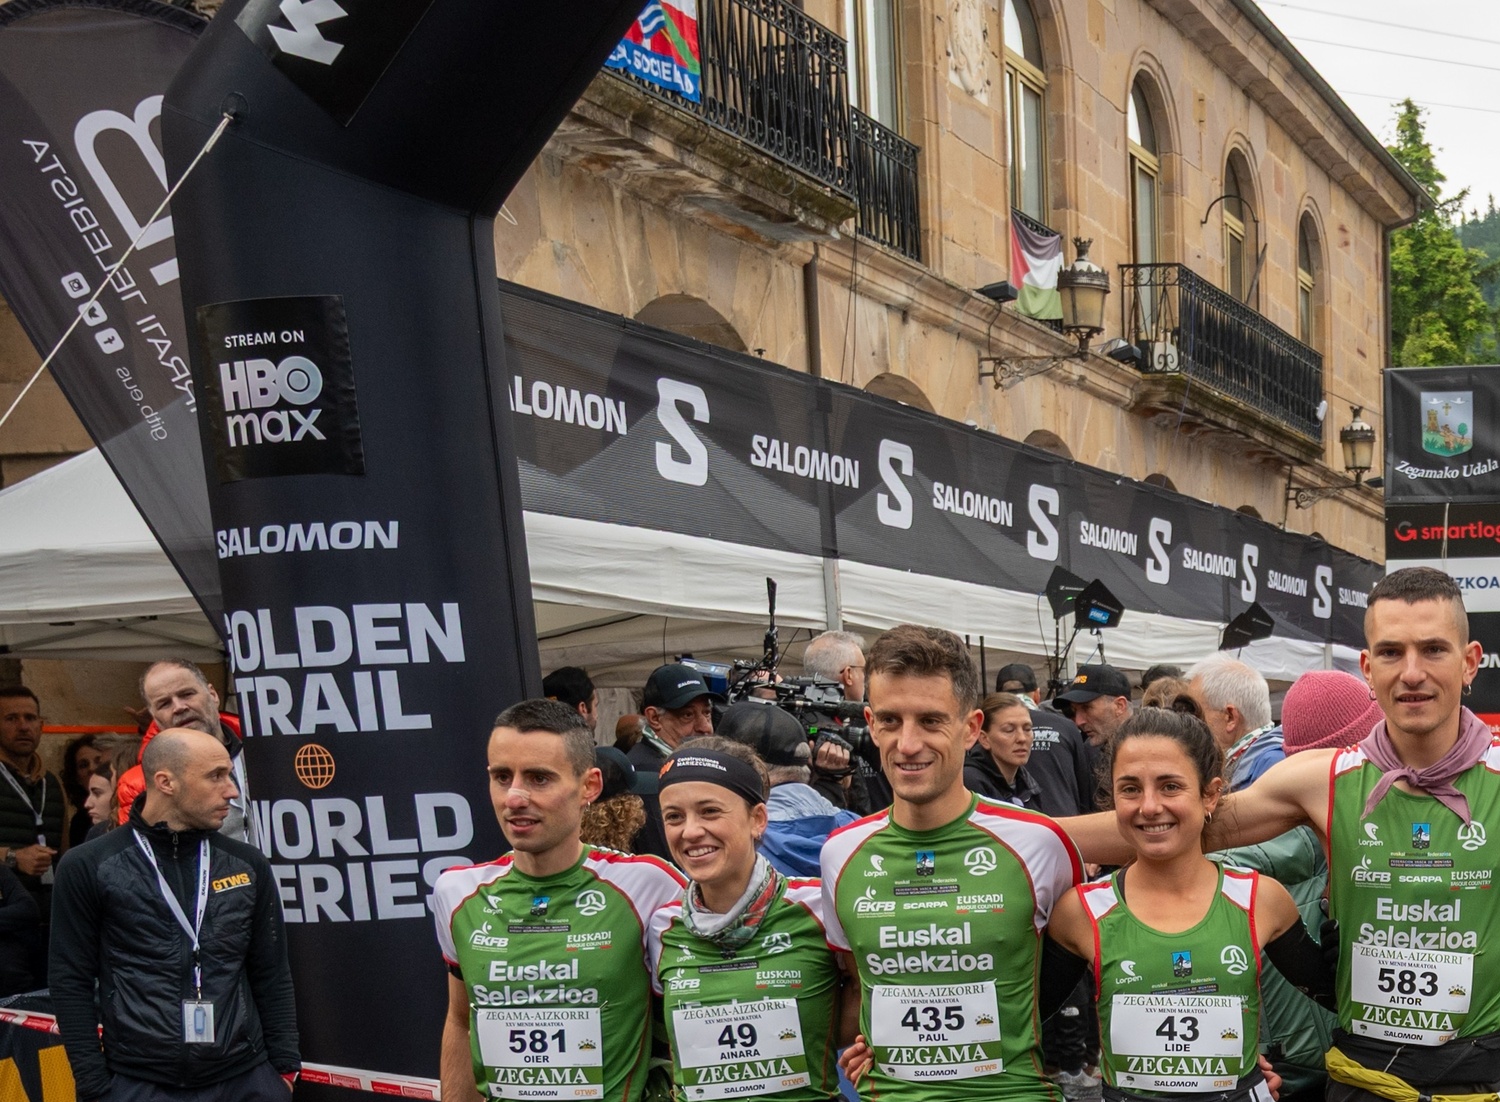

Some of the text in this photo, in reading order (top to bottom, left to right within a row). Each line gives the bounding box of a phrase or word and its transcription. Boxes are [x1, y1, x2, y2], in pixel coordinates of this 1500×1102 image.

[224, 330, 305, 348] STREAM ON
[219, 355, 323, 411] HBO
[227, 408, 326, 447] max
[1395, 459, 1499, 480] Zegamako Udala
[750, 434, 860, 489] SALOMON
[933, 482, 1013, 528] SALOMON
[1080, 520, 1138, 556] SALOMON
[1183, 547, 1236, 579] SALOMON
[1268, 569, 1307, 597] SALOMON
[216, 520, 399, 559] SALOMON
[234, 670, 432, 737] TRAIL
[212, 873, 250, 892] GTWS
[1451, 870, 1492, 880] EUSKADI
[272, 856, 462, 924] ERIES
[957, 894, 1003, 904] EUSKADI
[858, 901, 896, 912] EKFB
[903, 901, 948, 909] SCARPA
[1376, 898, 1461, 921] Euskal
[567, 931, 611, 941] EUSKADI
[879, 922, 971, 948] Euskal
[1360, 923, 1477, 949] Selekzioa
[866, 950, 994, 975] Selekzioa
[1360, 947, 1463, 965] ZEGAMA-AIZKORRI
[489, 959, 578, 981] Euskal
[756, 970, 801, 979] EUSKADI
[881, 985, 985, 998] ZEGAMA-AIZKORRI
[1378, 968, 1438, 996] 583
[473, 985, 598, 1005] Selekzioa
[1123, 997, 1232, 1007] ZEGAMA-AIZKORRI
[1389, 996, 1422, 1006] AITOR
[486, 1011, 589, 1020] ZEGAMA-AIZKORRI
[683, 1001, 787, 1020] ZEGAMA-AIZKORRI
[901, 1006, 965, 1031] 435
[1363, 1005, 1453, 1030] ZEGAMA
[718, 1023, 758, 1049] 49
[919, 1033, 948, 1042] PAUL
[1156, 1016, 1199, 1041] 43
[1384, 1031, 1423, 1041] SALOMON
[509, 1029, 566, 1053] 581
[720, 1049, 760, 1060] AINARA
[887, 1044, 989, 1064] ZEGAMA
[495, 1068, 589, 1084] ZEGAMA
[696, 1059, 794, 1084] ZEGAMA
[1127, 1057, 1228, 1075] ZEGAMA
[724, 1084, 765, 1093] SALOMON
